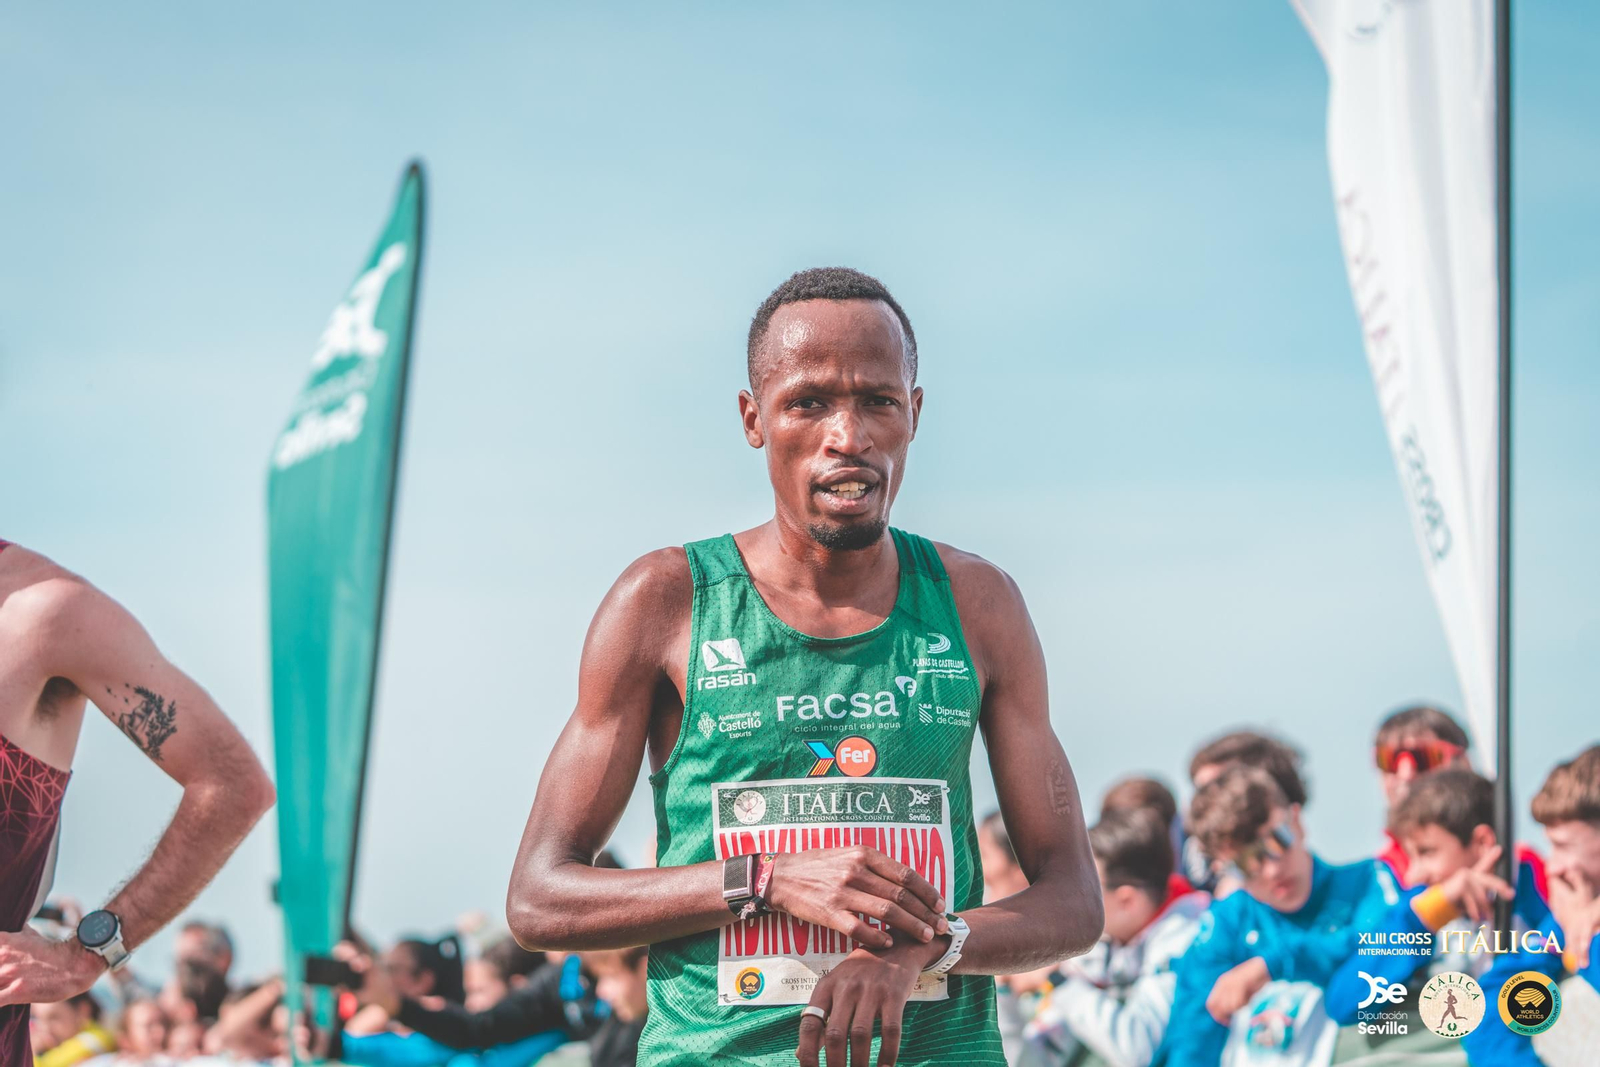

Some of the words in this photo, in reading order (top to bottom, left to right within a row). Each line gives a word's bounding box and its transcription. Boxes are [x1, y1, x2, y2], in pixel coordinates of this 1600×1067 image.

[697, 670, 756, 690] rasán
[776, 691, 900, 721] Facsa
[718, 718, 762, 732] Castelló
[794, 725, 818, 733] ciclo
[821, 723, 857, 732] integral
[860, 722, 875, 730] del
[878, 722, 901, 731] agua
[840, 747, 871, 764] Fer
[782, 787, 894, 816] ITÁLICA
